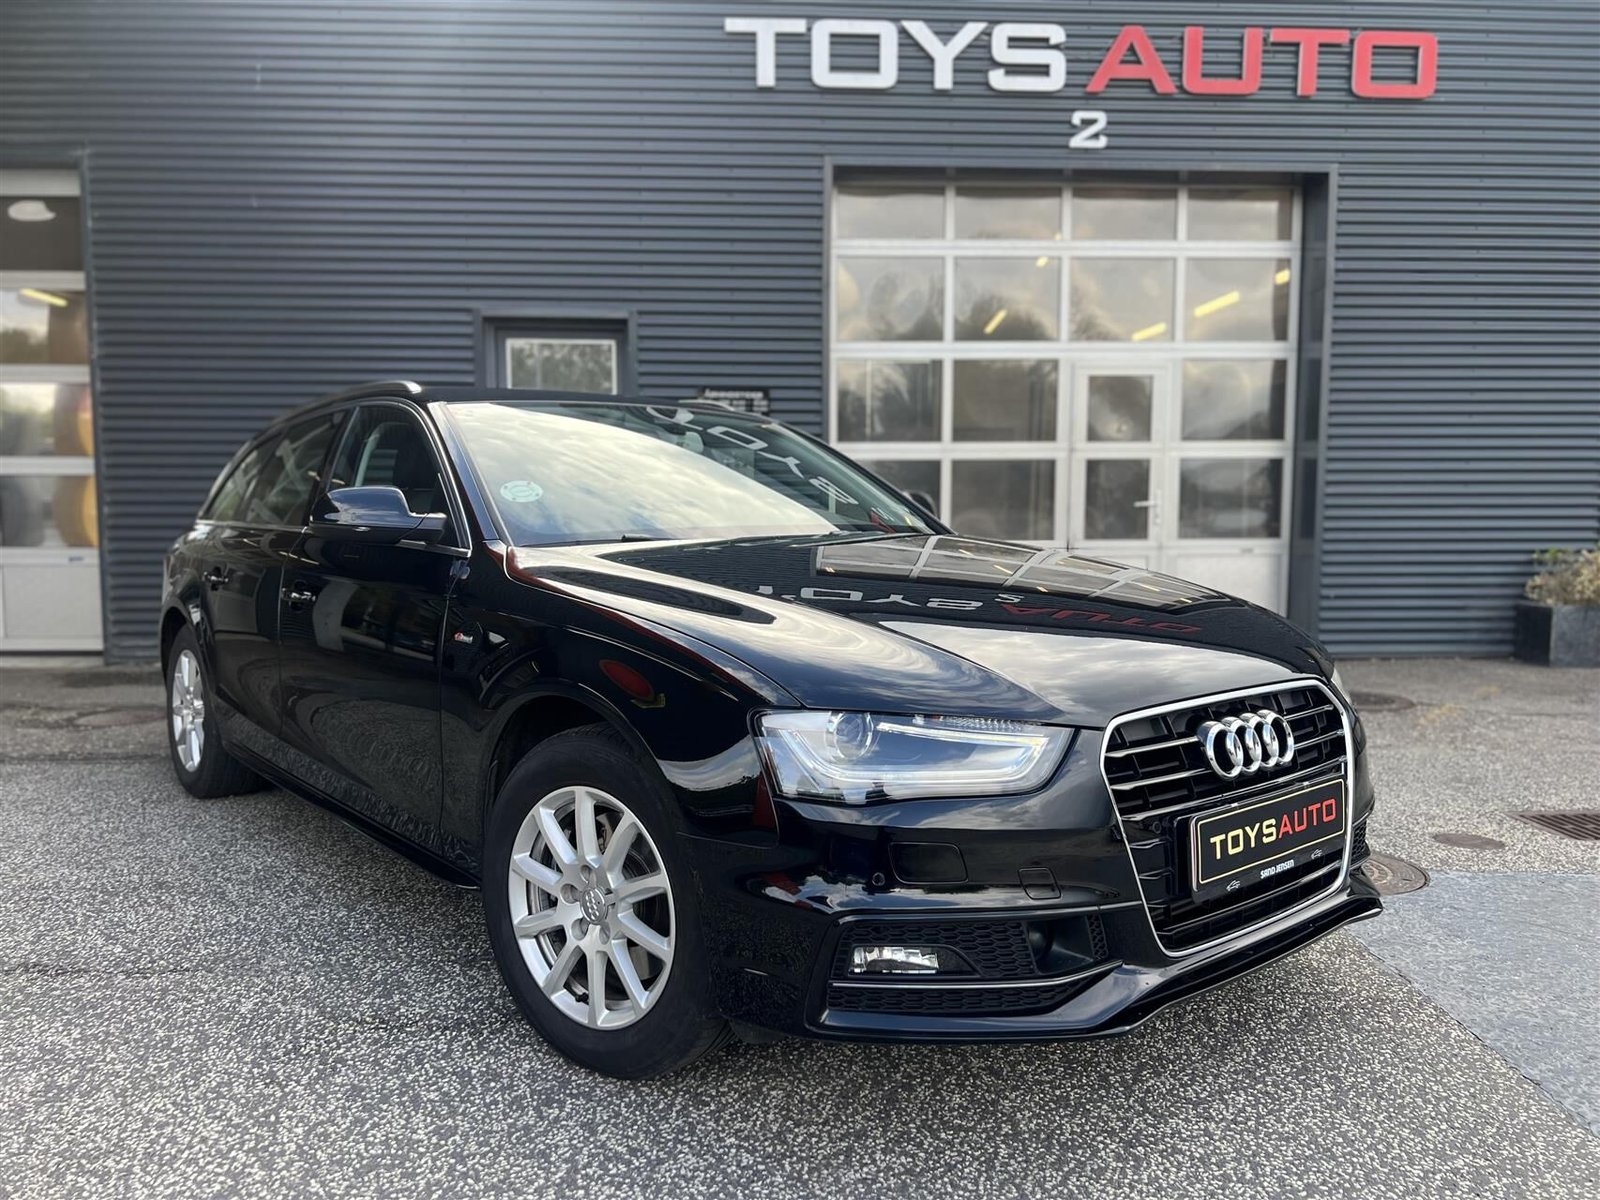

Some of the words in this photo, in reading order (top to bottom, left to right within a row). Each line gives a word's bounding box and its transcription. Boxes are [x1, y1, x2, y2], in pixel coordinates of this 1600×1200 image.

[724, 17, 1067, 92] TOYS
[1085, 25, 1439, 99] AUTO
[1069, 110, 1109, 149] 2
[1210, 798, 1337, 860] TOYSAUTO
